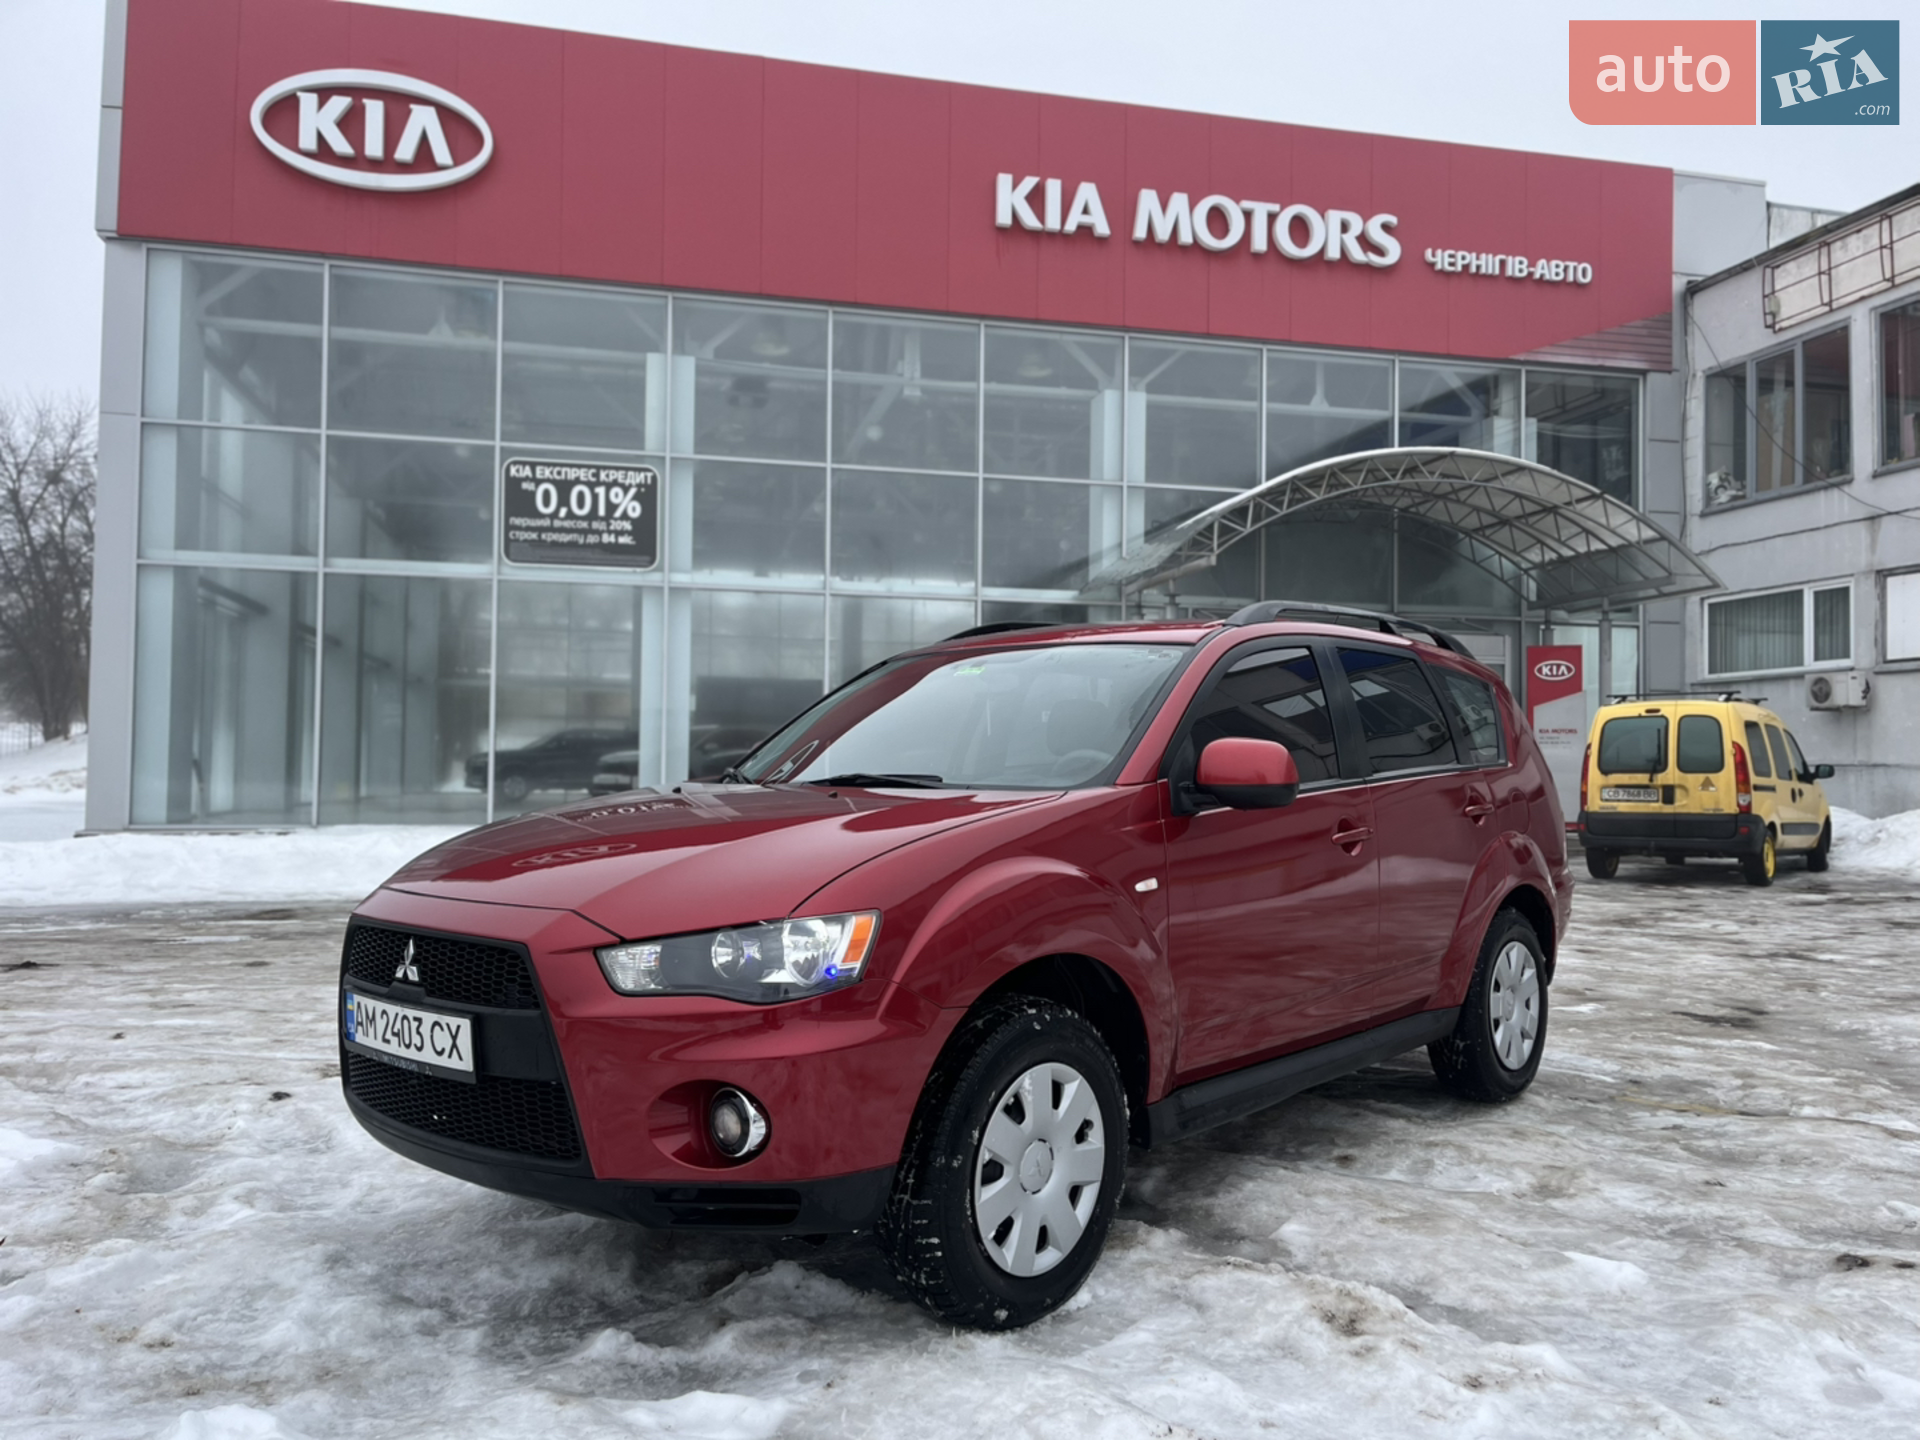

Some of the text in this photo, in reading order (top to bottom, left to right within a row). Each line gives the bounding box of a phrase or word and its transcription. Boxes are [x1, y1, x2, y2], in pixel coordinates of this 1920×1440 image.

[296, 90, 455, 169] KIA
[995, 172, 1402, 268] KIA MOTORS
[1424, 247, 1593, 285] ЧЕРНІГІВ-АВТО
[509, 464, 654, 486] KIA ЕКСПРЕС КРЕДИТ
[521, 480, 536, 491] від
[509, 517, 632, 531] перший внесок від 20%
[509, 530, 636, 545] строк кредиту до 84 міс.
[1541, 664, 1569, 676] KIA
[355, 1001, 463, 1062] AM 2403 CX
